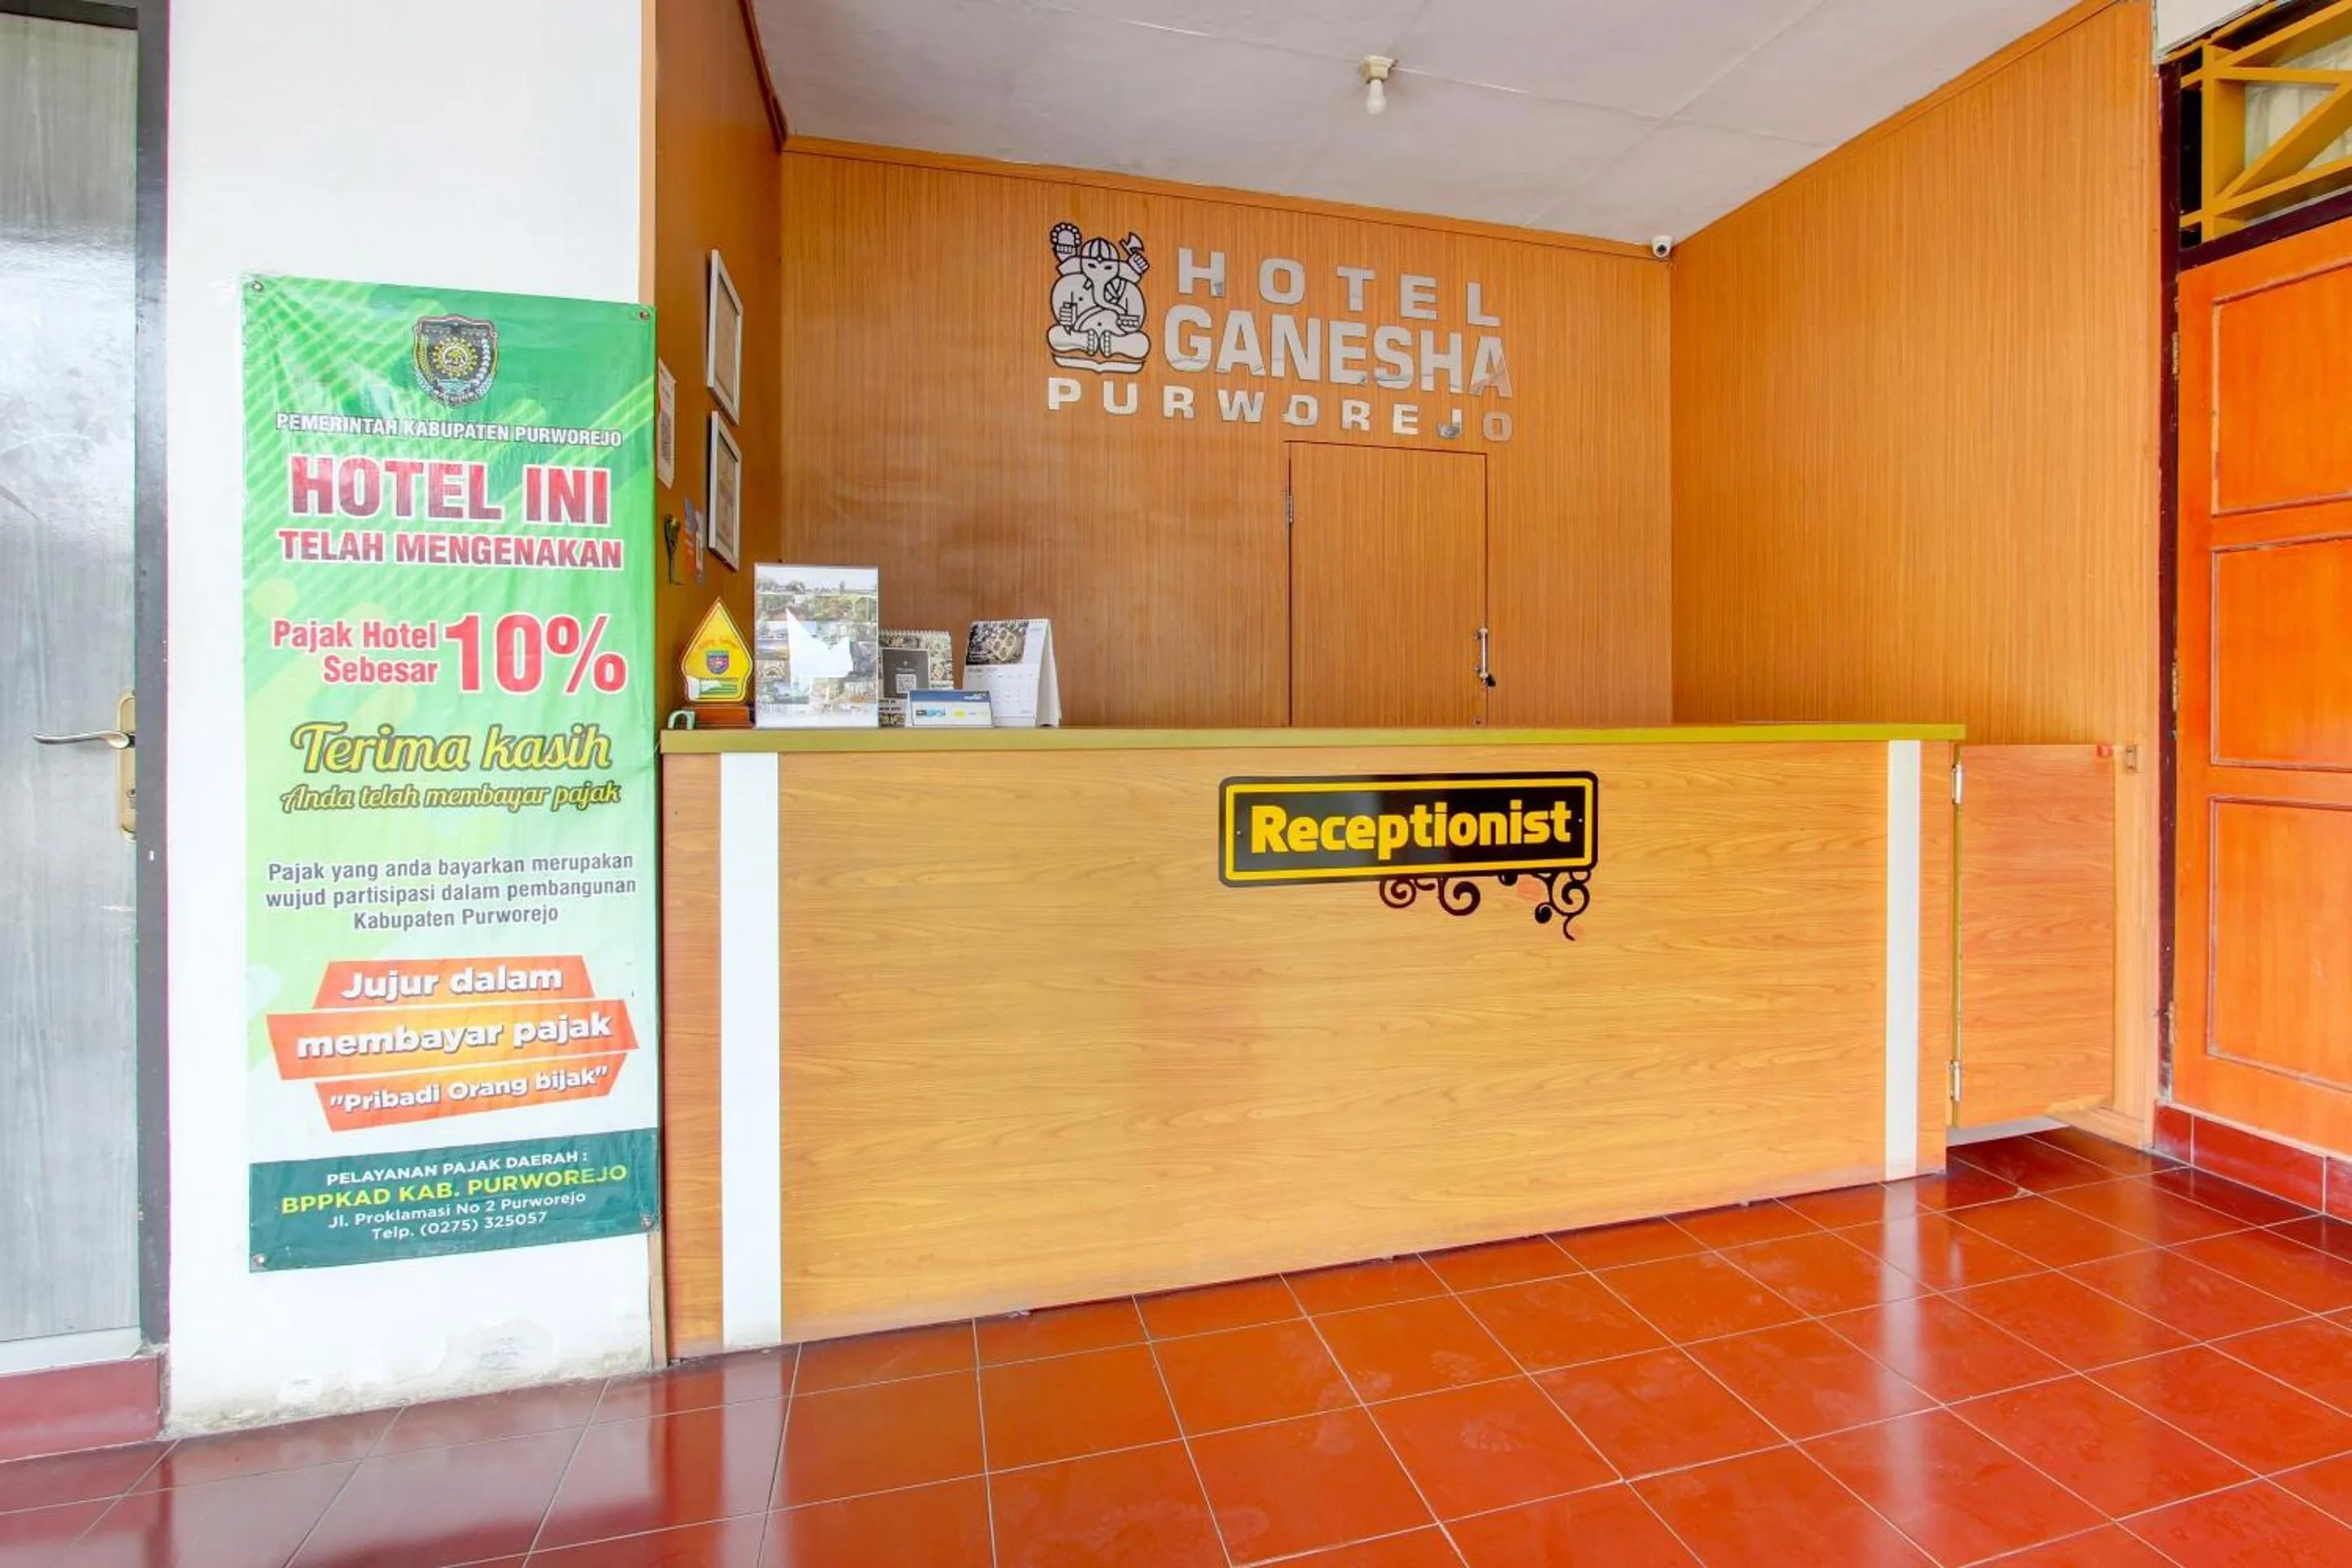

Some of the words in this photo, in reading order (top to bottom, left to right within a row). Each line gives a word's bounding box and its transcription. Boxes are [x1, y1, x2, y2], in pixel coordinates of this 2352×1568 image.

[1178, 247, 1501, 327] HOTEL
[1163, 304, 1513, 399] GANESHA
[1048, 376, 1513, 442] PURWOREJO
[276, 412, 398, 436] PEMERINTAH
[403, 418, 509, 442] KABUPATEN
[515, 426, 623, 448] PURWOREJO
[290, 455, 502, 520] HOTEL
[525, 464, 611, 526] INI
[278, 530, 384, 563] TELAH
[396, 533, 623, 569] MENGENAKAN
[274, 619, 353, 653] Pajak
[363, 621, 438, 650] Hotel
[444, 613, 627, 694] 10%
[323, 656, 439, 684] Sebesar
[291, 720, 470, 773] Terima
[480, 720, 612, 771] kasih
[281, 783, 354, 813] Anda
[359, 783, 420, 810] telah
[424, 783, 550, 813] membayar
[550, 780, 621, 812] pajak
[1250, 800, 1572, 860] Receptionist
[269, 862, 325, 883] Pajak
[332, 863, 378, 882] yang
[385, 858, 431, 877] anda
[438, 857, 525, 879] bayarkan
[532, 853, 634, 876] merupakan
[265, 888, 326, 909] wujud
[332, 884, 435, 908] partisipasi
[441, 881, 501, 902] dalam
[506, 877, 637, 902] pembangunan
[354, 911, 455, 932] Kabupaten
[462, 906, 559, 926] Purworejo
[341, 969, 439, 1003] Jujur
[450, 964, 564, 996] dalam
[296, 1018, 504, 1059] membayar
[513, 1011, 612, 1045] pajak
[448, 1071, 528, 1100] Orang
[327, 1163, 439, 1187] PELAYANAN
[443, 1157, 501, 1177] PAJAK
[506, 1150, 579, 1169] DAERAH
[281, 1186, 391, 1215] BPPKAD
[399, 1180, 461, 1202] KAB.
[467, 1165, 628, 1194] PURWOREJO
[327, 1214, 349, 1229] Jl.
[354, 1202, 452, 1227] Proklamasi
[457, 1201, 480, 1215] No
[485, 1199, 496, 1213] 2
[501, 1191, 586, 1213] Purworejo
[371, 1223, 415, 1243] Telp.
[420, 1218, 479, 1237] (0275)
[483, 1210, 547, 1231] 325057
